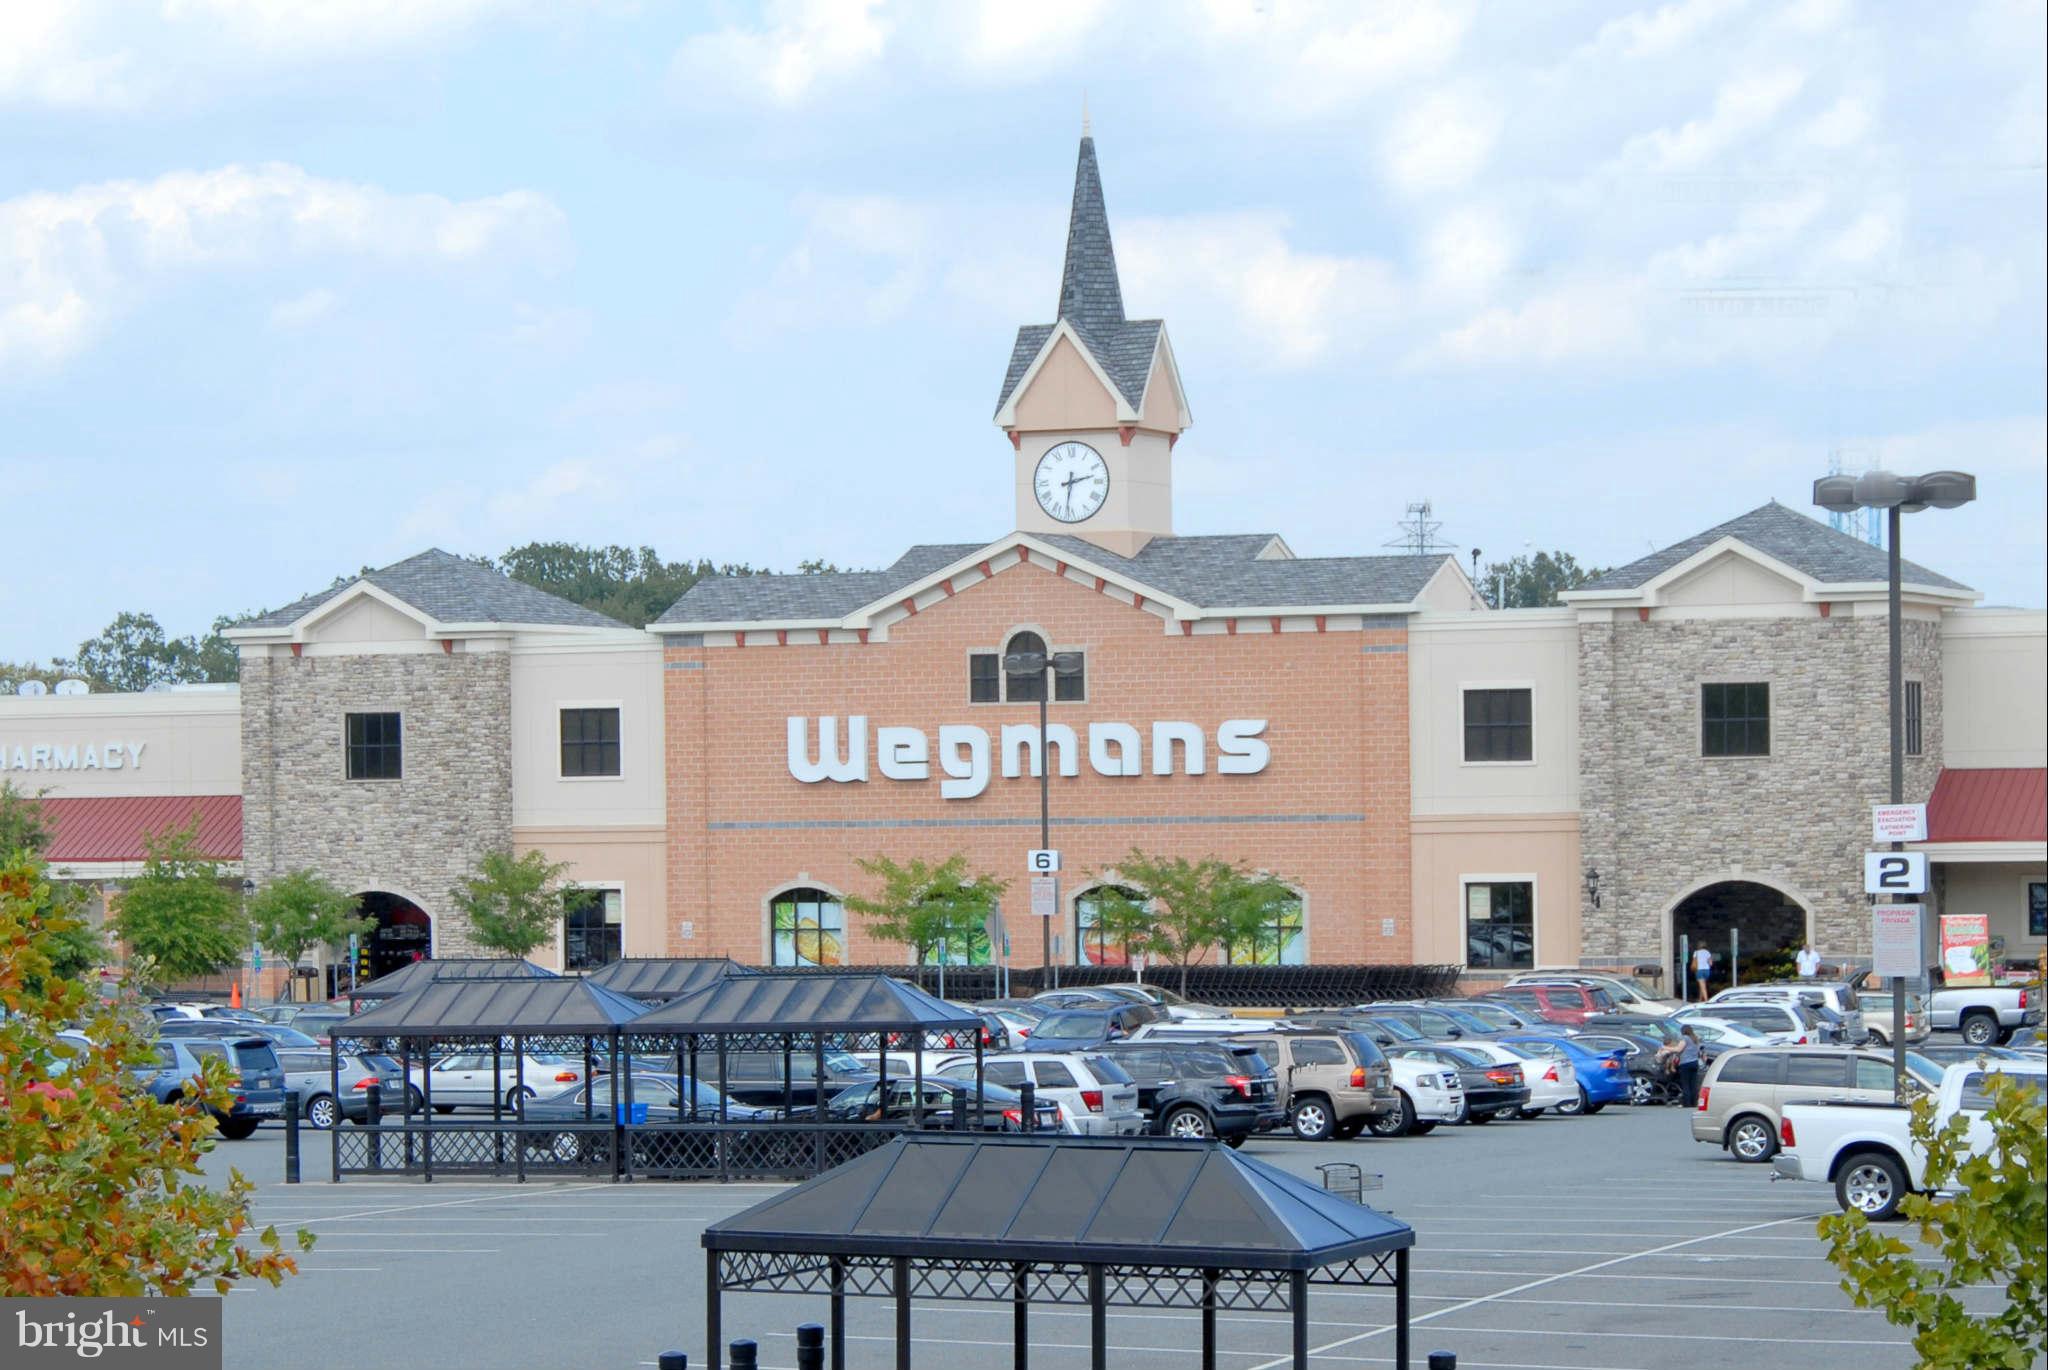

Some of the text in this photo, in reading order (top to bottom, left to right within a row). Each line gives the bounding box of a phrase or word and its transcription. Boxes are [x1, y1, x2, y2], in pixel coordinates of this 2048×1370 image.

[787, 715, 1271, 799] Wegmans
[1036, 853, 1050, 868] 6
[1880, 857, 1909, 887] 2
